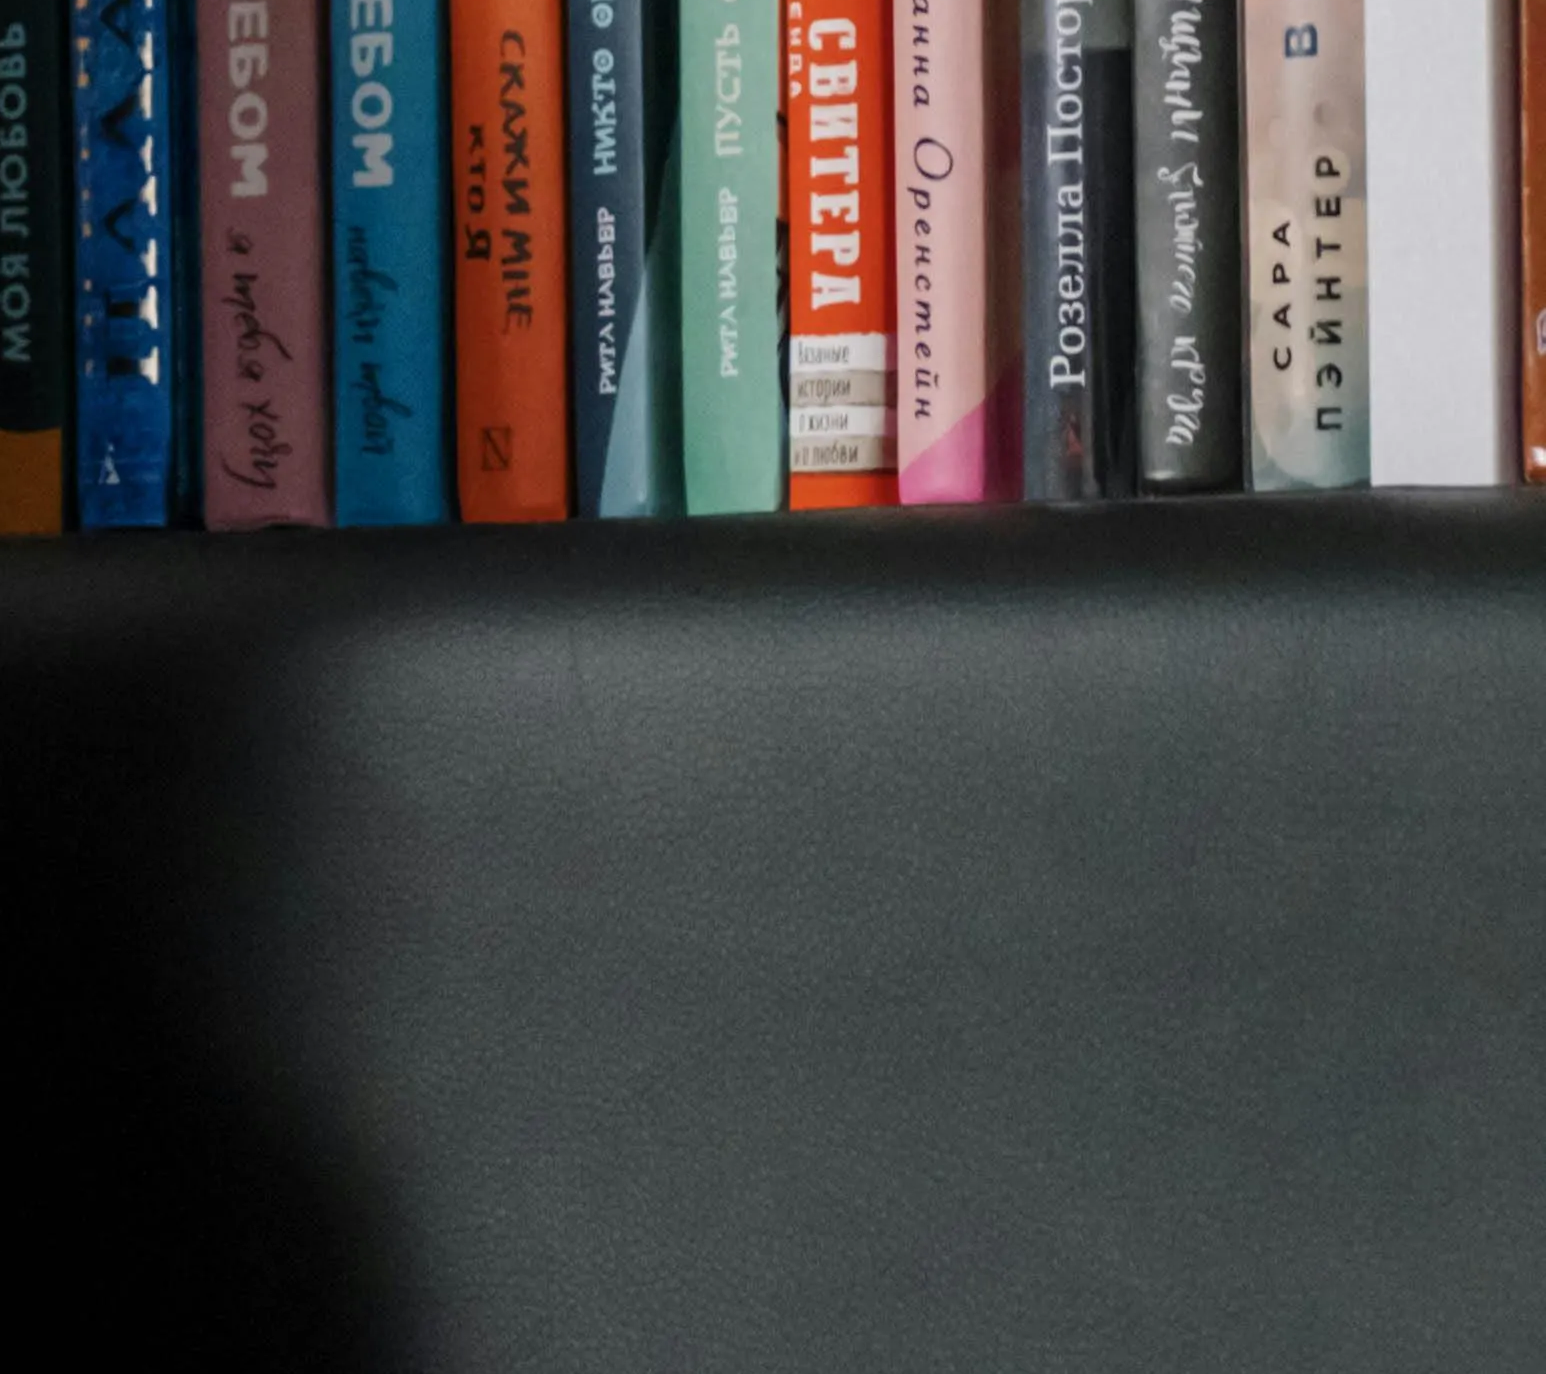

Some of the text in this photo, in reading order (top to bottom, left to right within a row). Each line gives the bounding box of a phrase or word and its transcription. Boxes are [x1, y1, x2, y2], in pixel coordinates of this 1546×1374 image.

[714, 22, 743, 157] ПУСТЬ
[1283, 22, 1320, 59] В
[591, 47, 619, 176] НИКТО
[807, 17, 862, 311] СВИТЕРА
[464, 124, 492, 262] КТО Я
[498, 28, 534, 331] СКАЖИ МНЕ
[0, 253, 32, 363] МОЯ
[719, 305, 742, 378] РИТА
[905, 135, 954, 420] Оренстейн
[1048, 182, 1086, 389] Розелла
[1272, 219, 1292, 371] САРА
[1308, 153, 1343, 431] ПЭЙНТЕР
[598, 322, 619, 395] РИТА
[797, 378, 852, 404] истории
[808, 412, 849, 432] жизни
[1166, 334, 1206, 447] круга
[812, 438, 859, 467] любви
